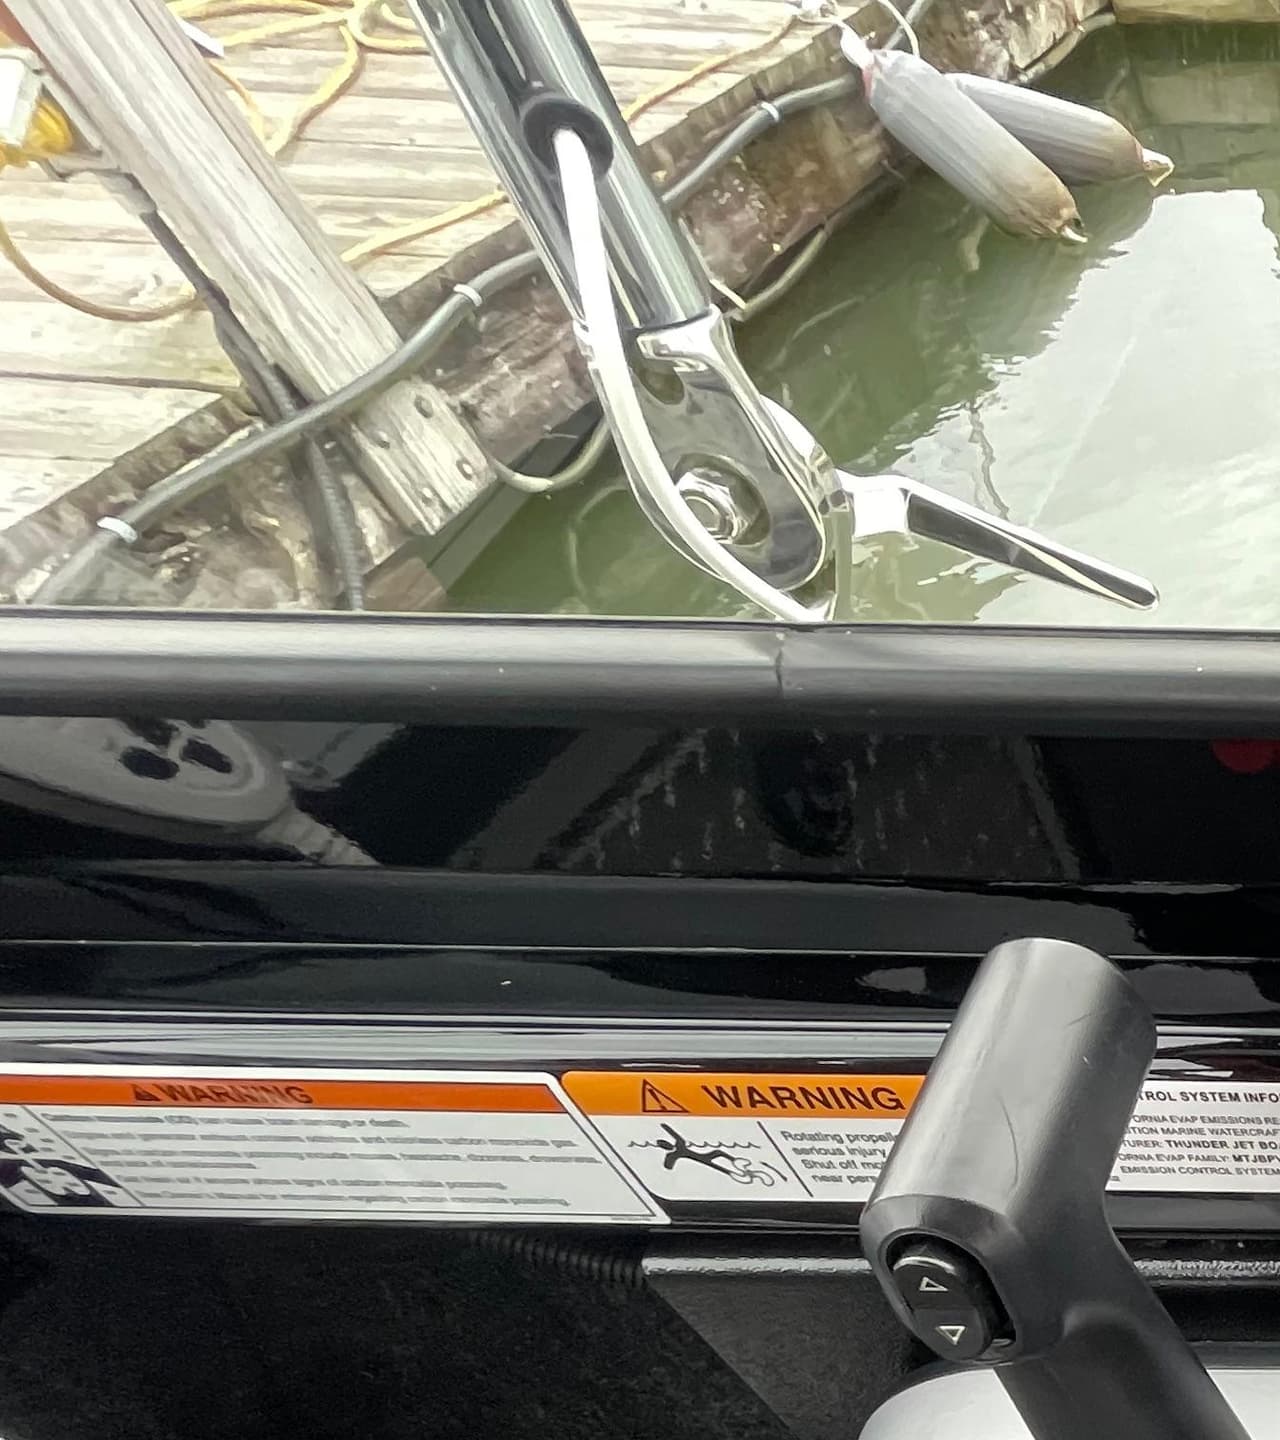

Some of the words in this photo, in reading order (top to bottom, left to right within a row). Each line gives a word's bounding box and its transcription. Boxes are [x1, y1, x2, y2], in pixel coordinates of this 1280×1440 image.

[702, 1084, 905, 1111] WARNING
[1181, 1091, 1241, 1102] SYSTEM
[1169, 1115, 1198, 1124] EVAP
[1200, 1116, 1264, 1125] EMISSIONS
[1160, 1127, 1207, 1136] MARINE
[780, 1130, 844, 1144] Rotating
[1164, 1140, 1229, 1149] THUNDER
[1231, 1141, 1255, 1149] JET
[1155, 1153, 1186, 1162] EVAP
[1120, 1165, 1177, 1174] EMISSION
[1178, 1166, 1233, 1175] CONTROL
